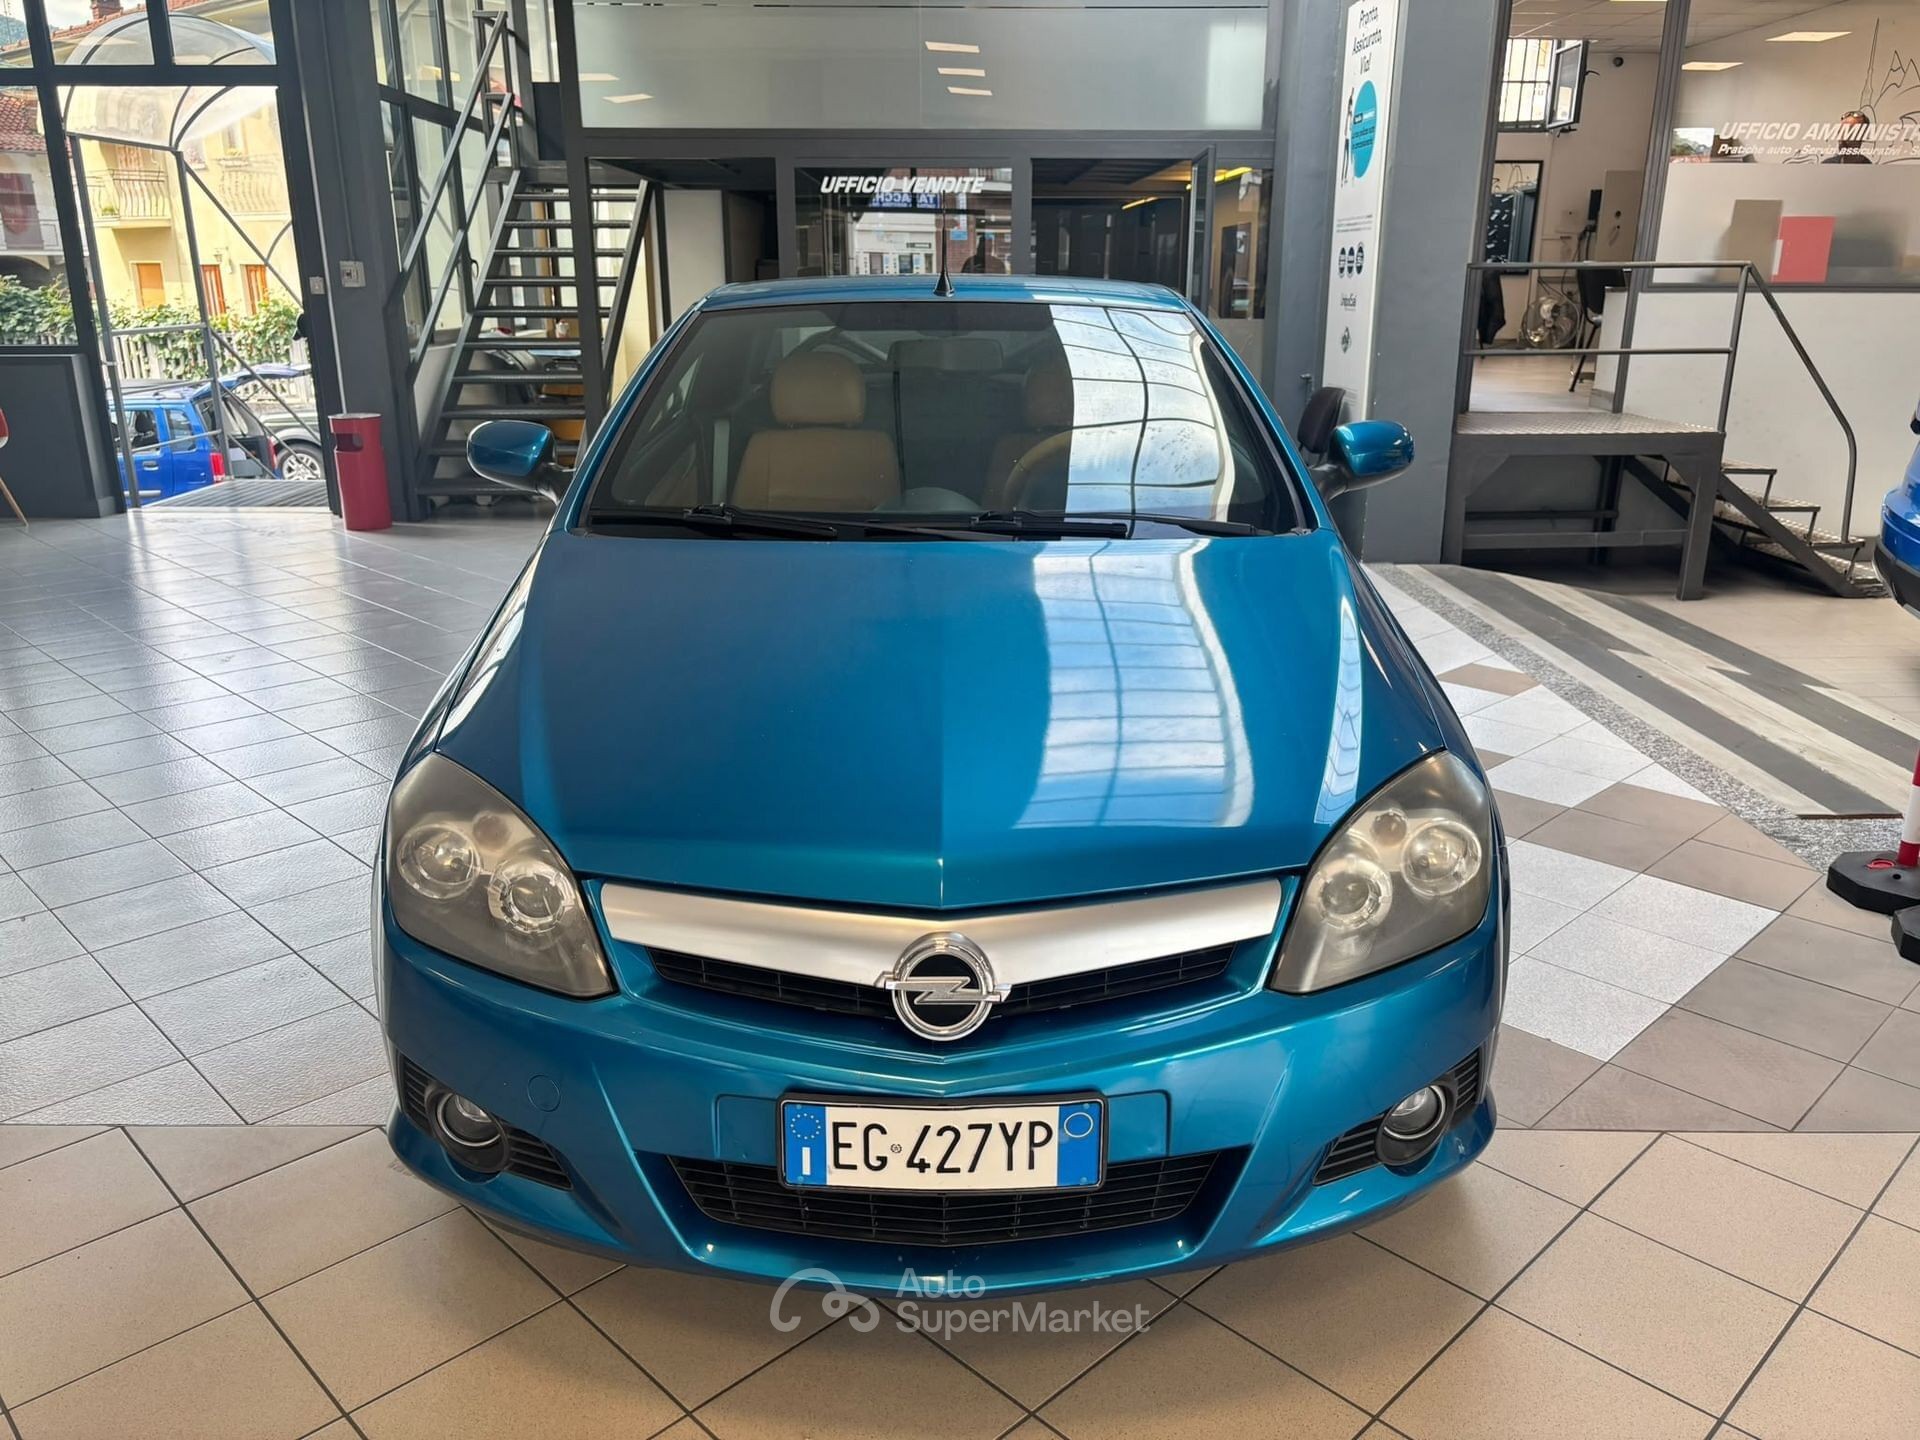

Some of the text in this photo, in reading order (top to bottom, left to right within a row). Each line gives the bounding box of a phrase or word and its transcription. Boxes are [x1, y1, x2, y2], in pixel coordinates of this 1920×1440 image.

[1359, 6, 1378, 29] Pronta,
[1352, 29, 1382, 56] Assicurata,
[1360, 52, 1372, 75] Via!
[1719, 121, 1801, 140] UFFICIO
[1717, 143, 1765, 155] Pratiche
[1767, 145, 1792, 155] auto
[1801, 144, 1838, 155] Servizi
[1839, 145, 1901, 156] assicurativi
[820, 176, 986, 194] UFFICIO VENDITE
